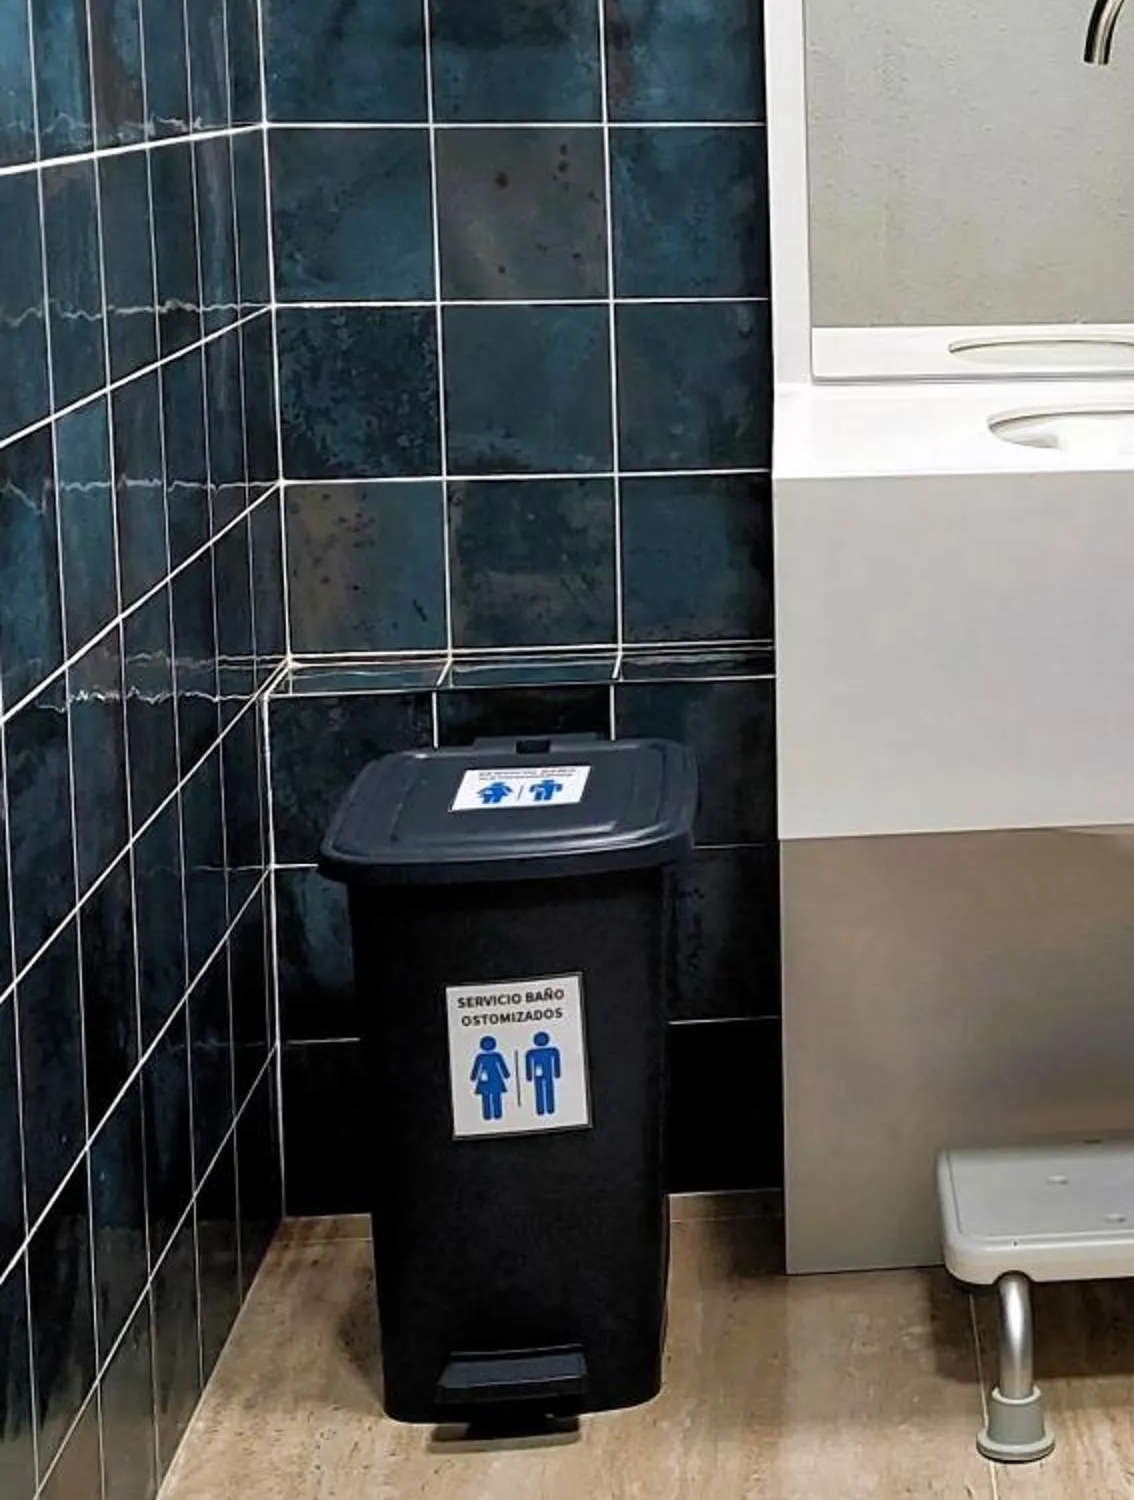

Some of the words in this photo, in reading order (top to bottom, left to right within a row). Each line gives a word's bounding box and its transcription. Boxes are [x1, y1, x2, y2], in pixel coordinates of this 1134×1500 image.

[457, 993, 522, 1009] SERVICIO
[525, 987, 565, 1002] BAÑO
[461, 1007, 563, 1027] OSTOMIZADOS
